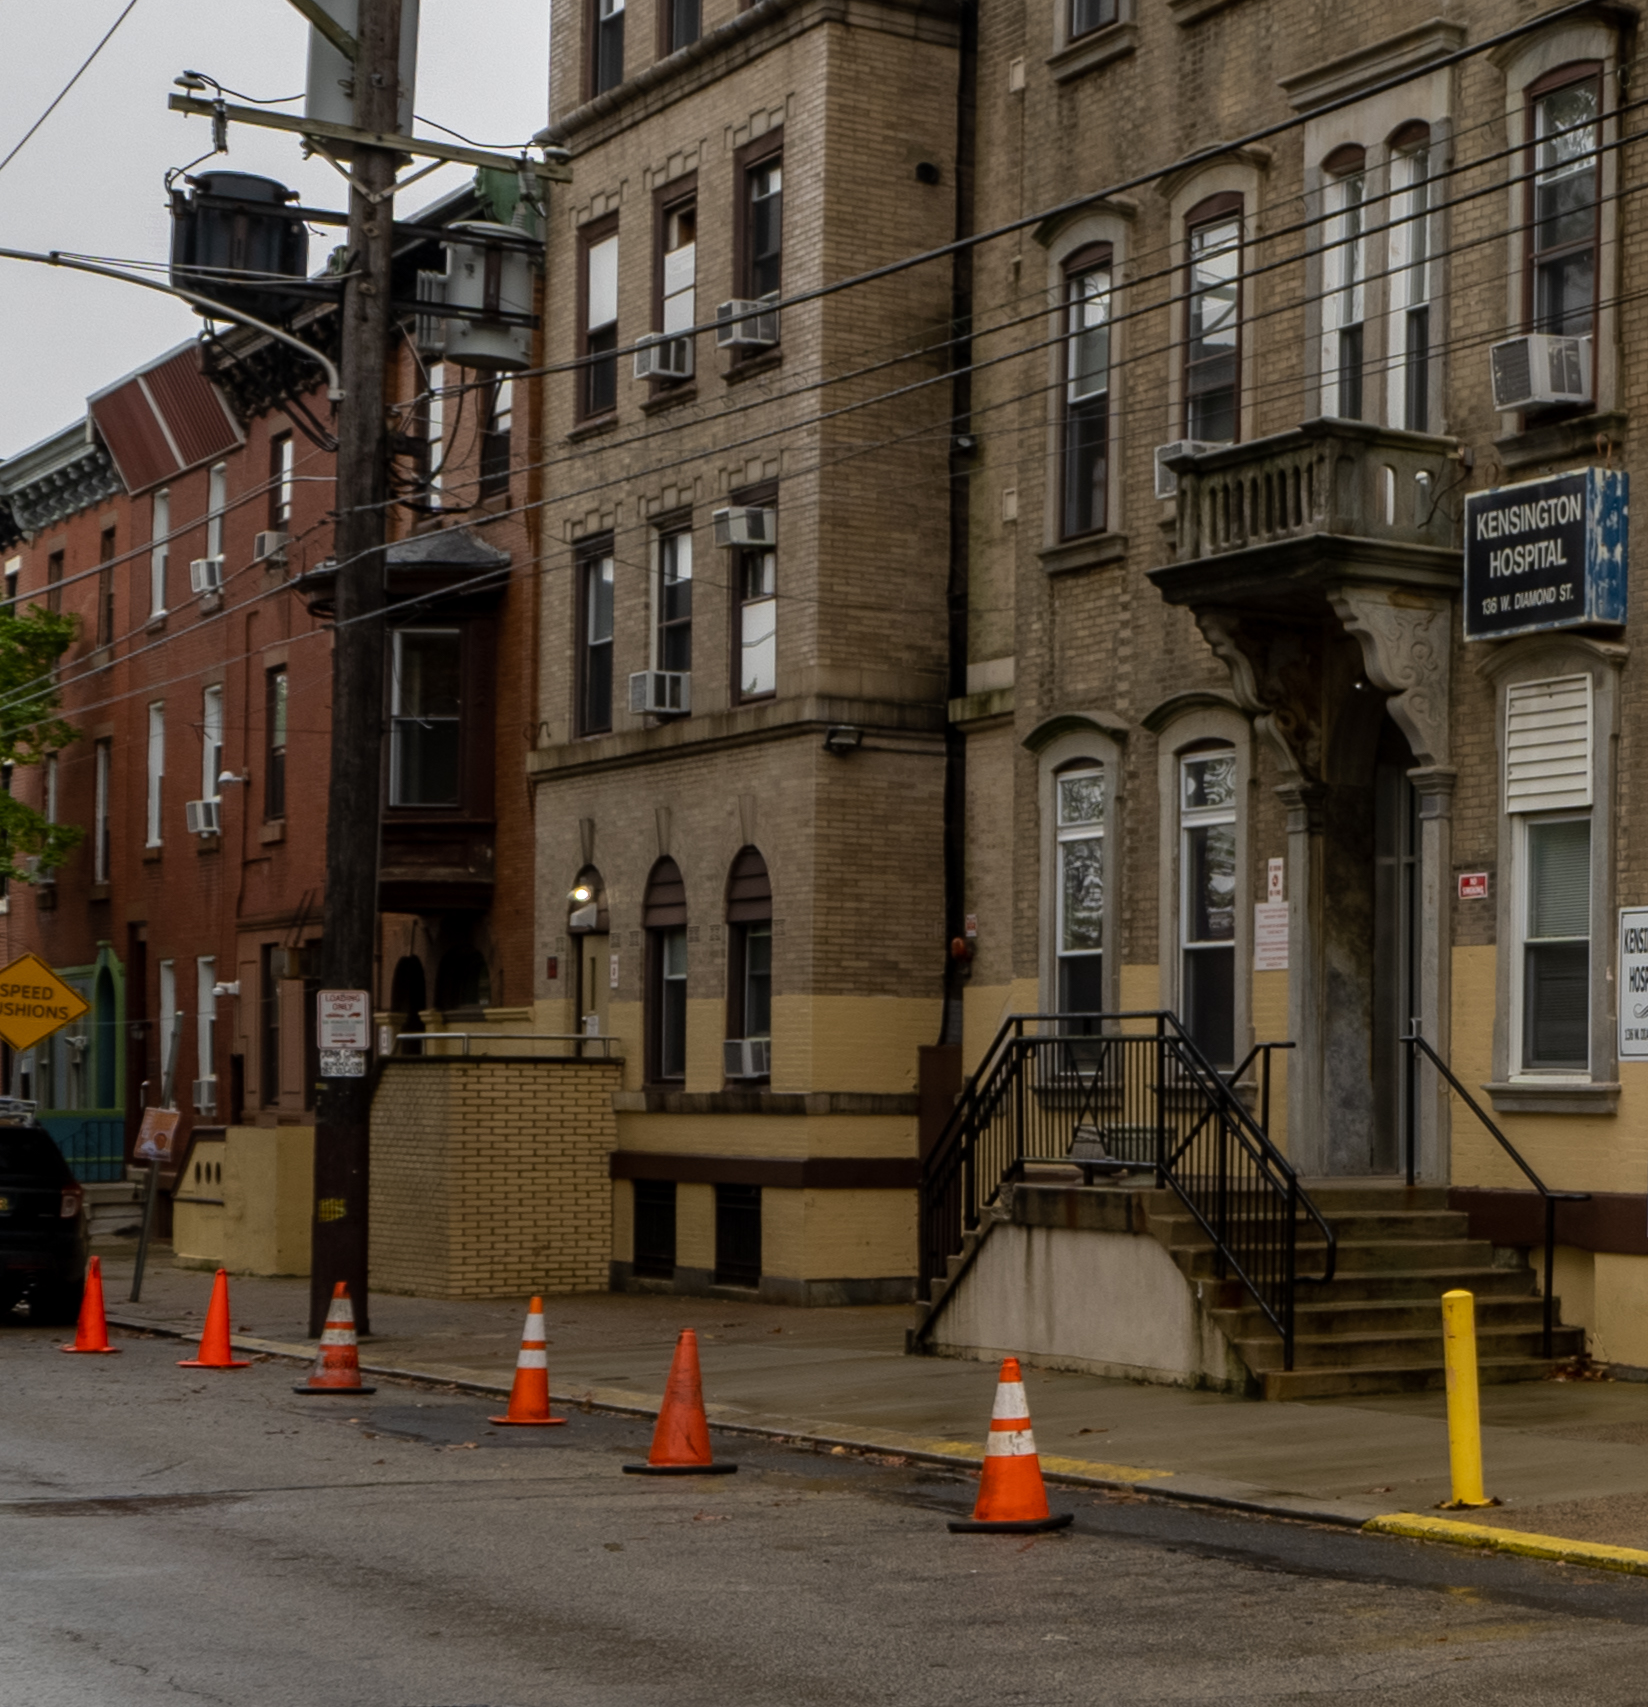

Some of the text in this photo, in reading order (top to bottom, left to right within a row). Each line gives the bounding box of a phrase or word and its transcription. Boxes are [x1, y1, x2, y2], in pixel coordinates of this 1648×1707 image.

[1476, 493, 1582, 541] KENSINGTON
[1489, 538, 1568, 578] HOSPITAL
[1482, 583, 1574, 615] 136 W. DIAMOND ST.
[0, 984, 53, 1000] SPEED
[0, 1002, 69, 1020] SHIONS
